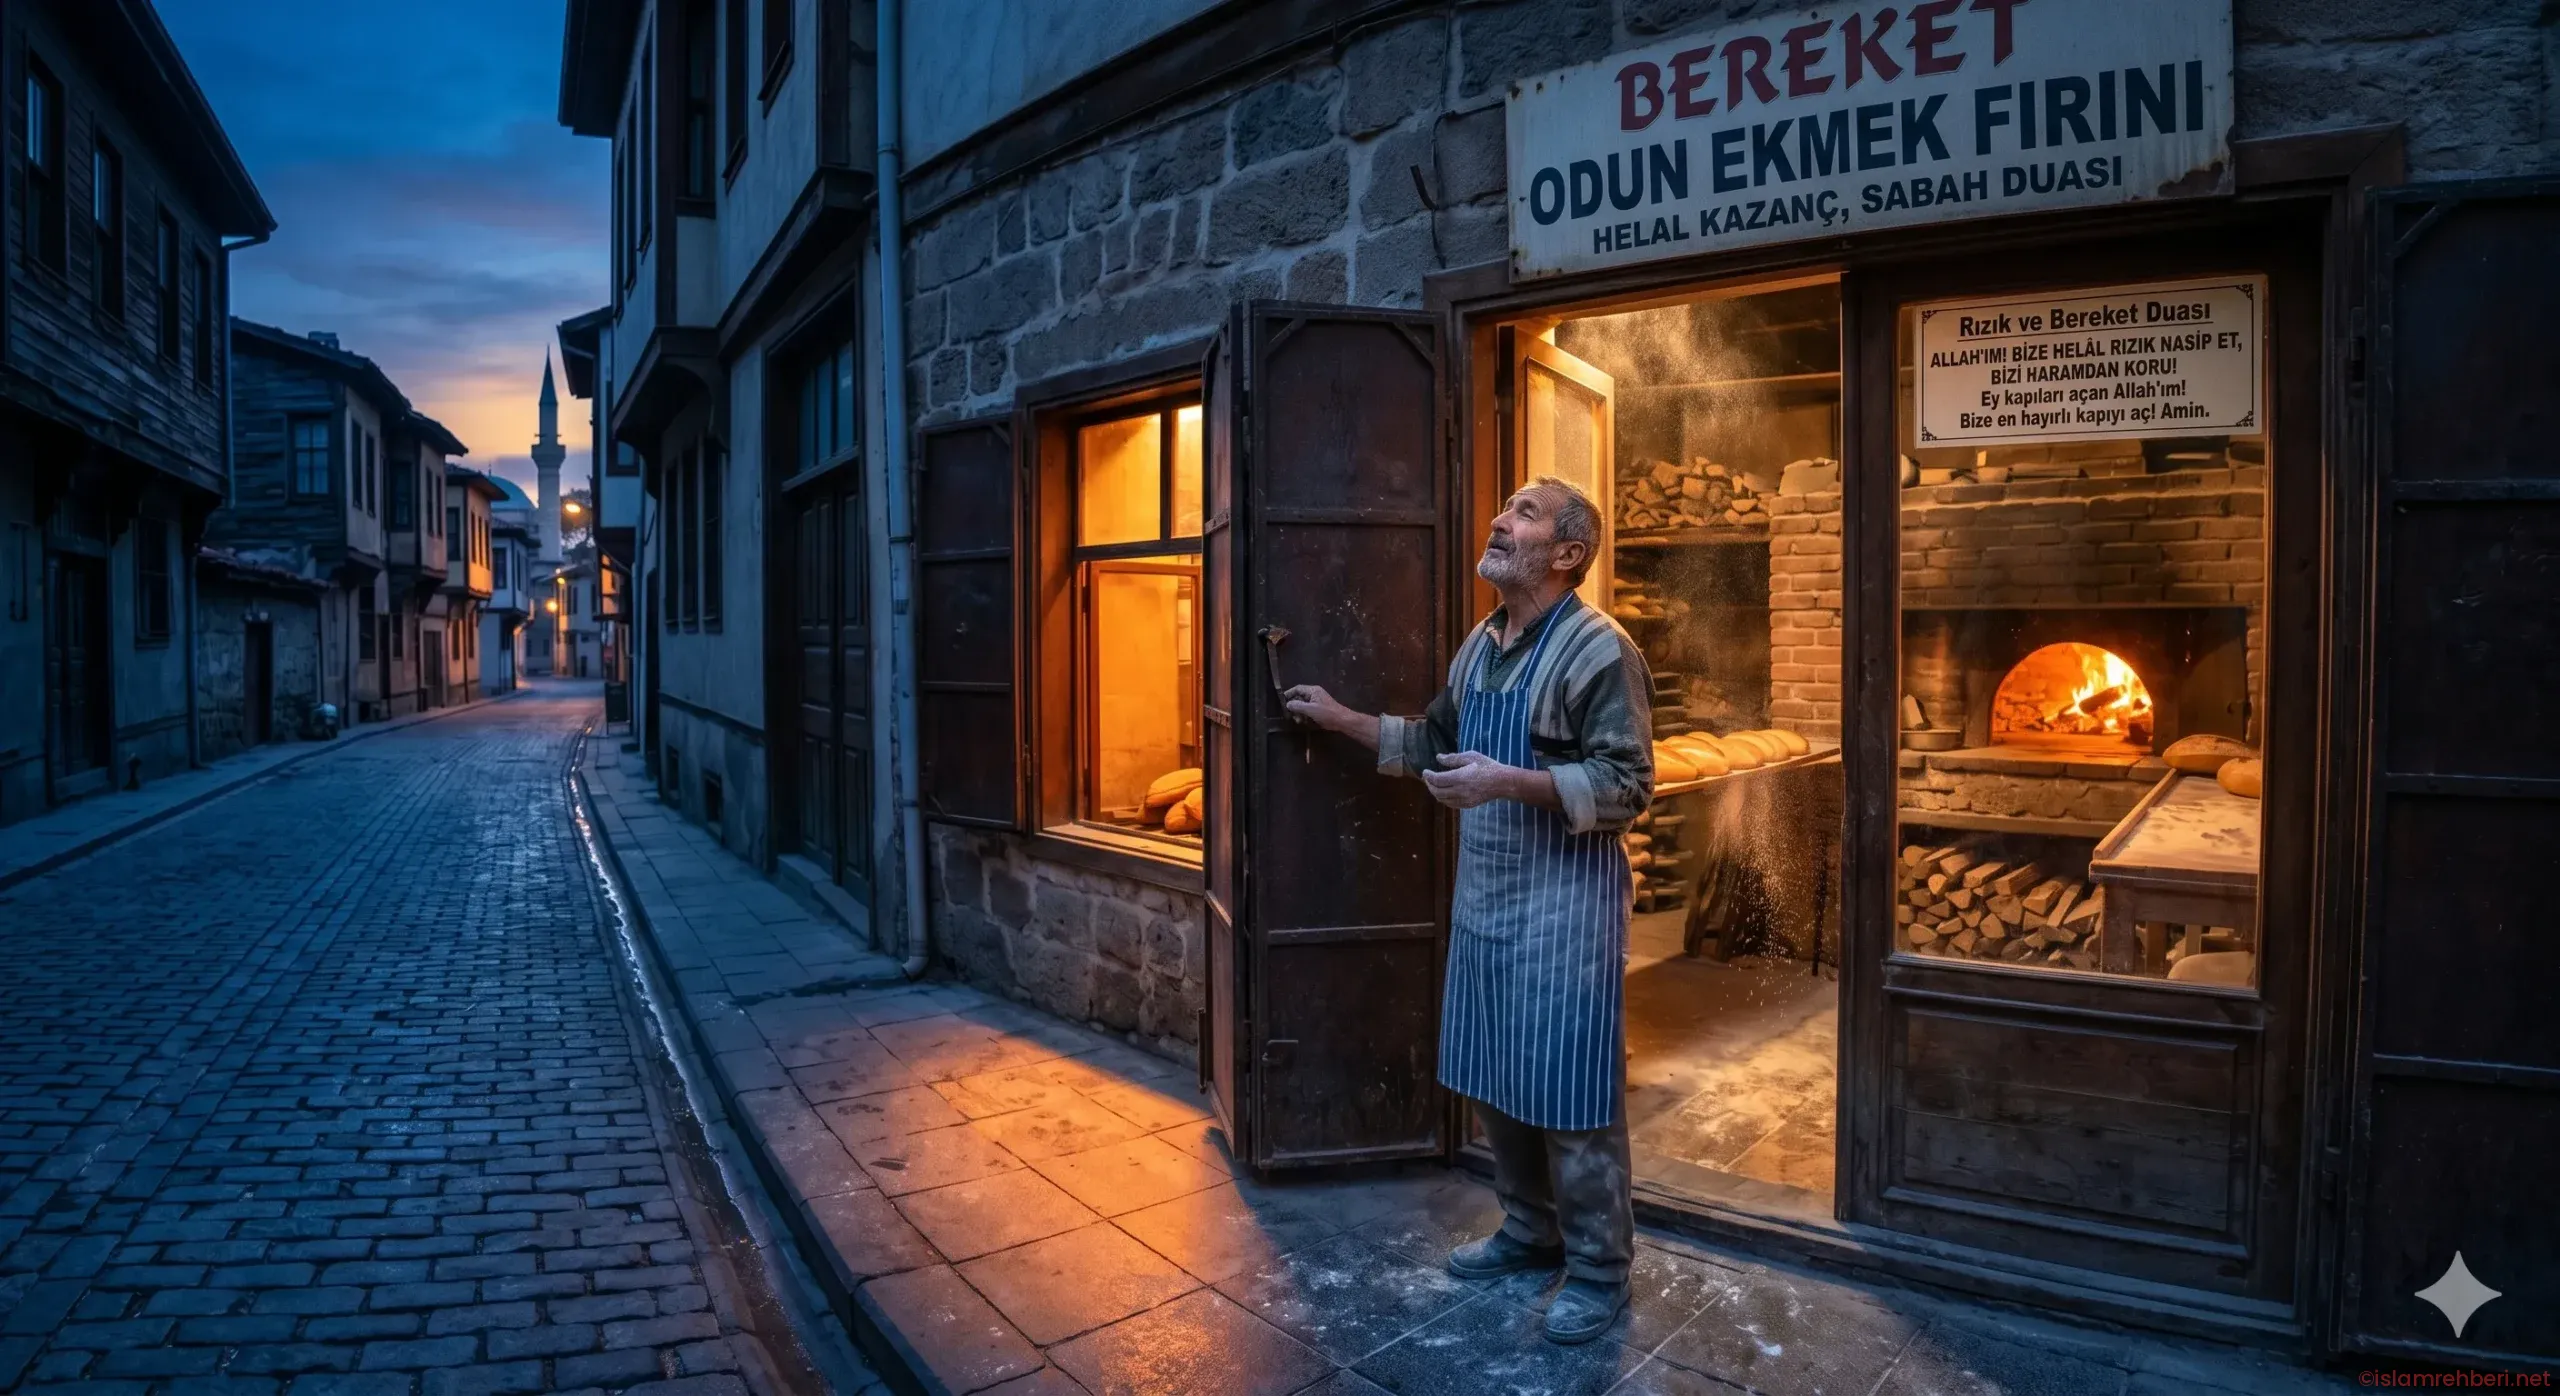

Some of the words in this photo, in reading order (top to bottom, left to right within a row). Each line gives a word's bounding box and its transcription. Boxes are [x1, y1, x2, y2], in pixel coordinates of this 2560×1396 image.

[1615, 0, 2029, 131] BEREKET
[1530, 139, 1689, 225] ODUN
[1711, 94, 1953, 195] EKMEK
[1974, 60, 2204, 155] FIRINI
[1592, 221, 1690, 254] HELAL
[1699, 193, 1850, 237] KAZANÇ,
[1860, 171, 1988, 213] SABAH
[2004, 156, 2123, 191] DUASI
[1960, 314, 2010, 336] Rızık
[2018, 314, 2043, 331] ve
[2050, 303, 2138, 329] Bereket
[2146, 301, 2210, 323] Duası
[1931, 347, 2007, 367] ALLAH'IM!
[2012, 341, 2048, 362] BİZE
[2053, 337, 2105, 358] HELÂL
[2111, 337, 2155, 355] RIZIK
[2160, 330, 2212, 352] NASİP
[2218, 332, 2243, 350] ET,
[1991, 365, 2022, 384] BİZİ
[2027, 361, 2119, 383] HARAMDAN
[2125, 358, 2177, 375] KORU!
[1981, 390, 2000, 409] Ey
[2004, 384, 2064, 409] kapıları
[2069, 388, 2109, 407] açan
[2113, 379, 2186, 399] Allah'ım!
[1960, 410, 1993, 429] Bize
[1997, 413, 2017, 428] en
[2021, 407, 2070, 431] hayırlı
[2076, 406, 2125, 429] kapıyı
[2130, 403, 2156, 424] aç!
[2161, 401, 2210, 420] Amin.
